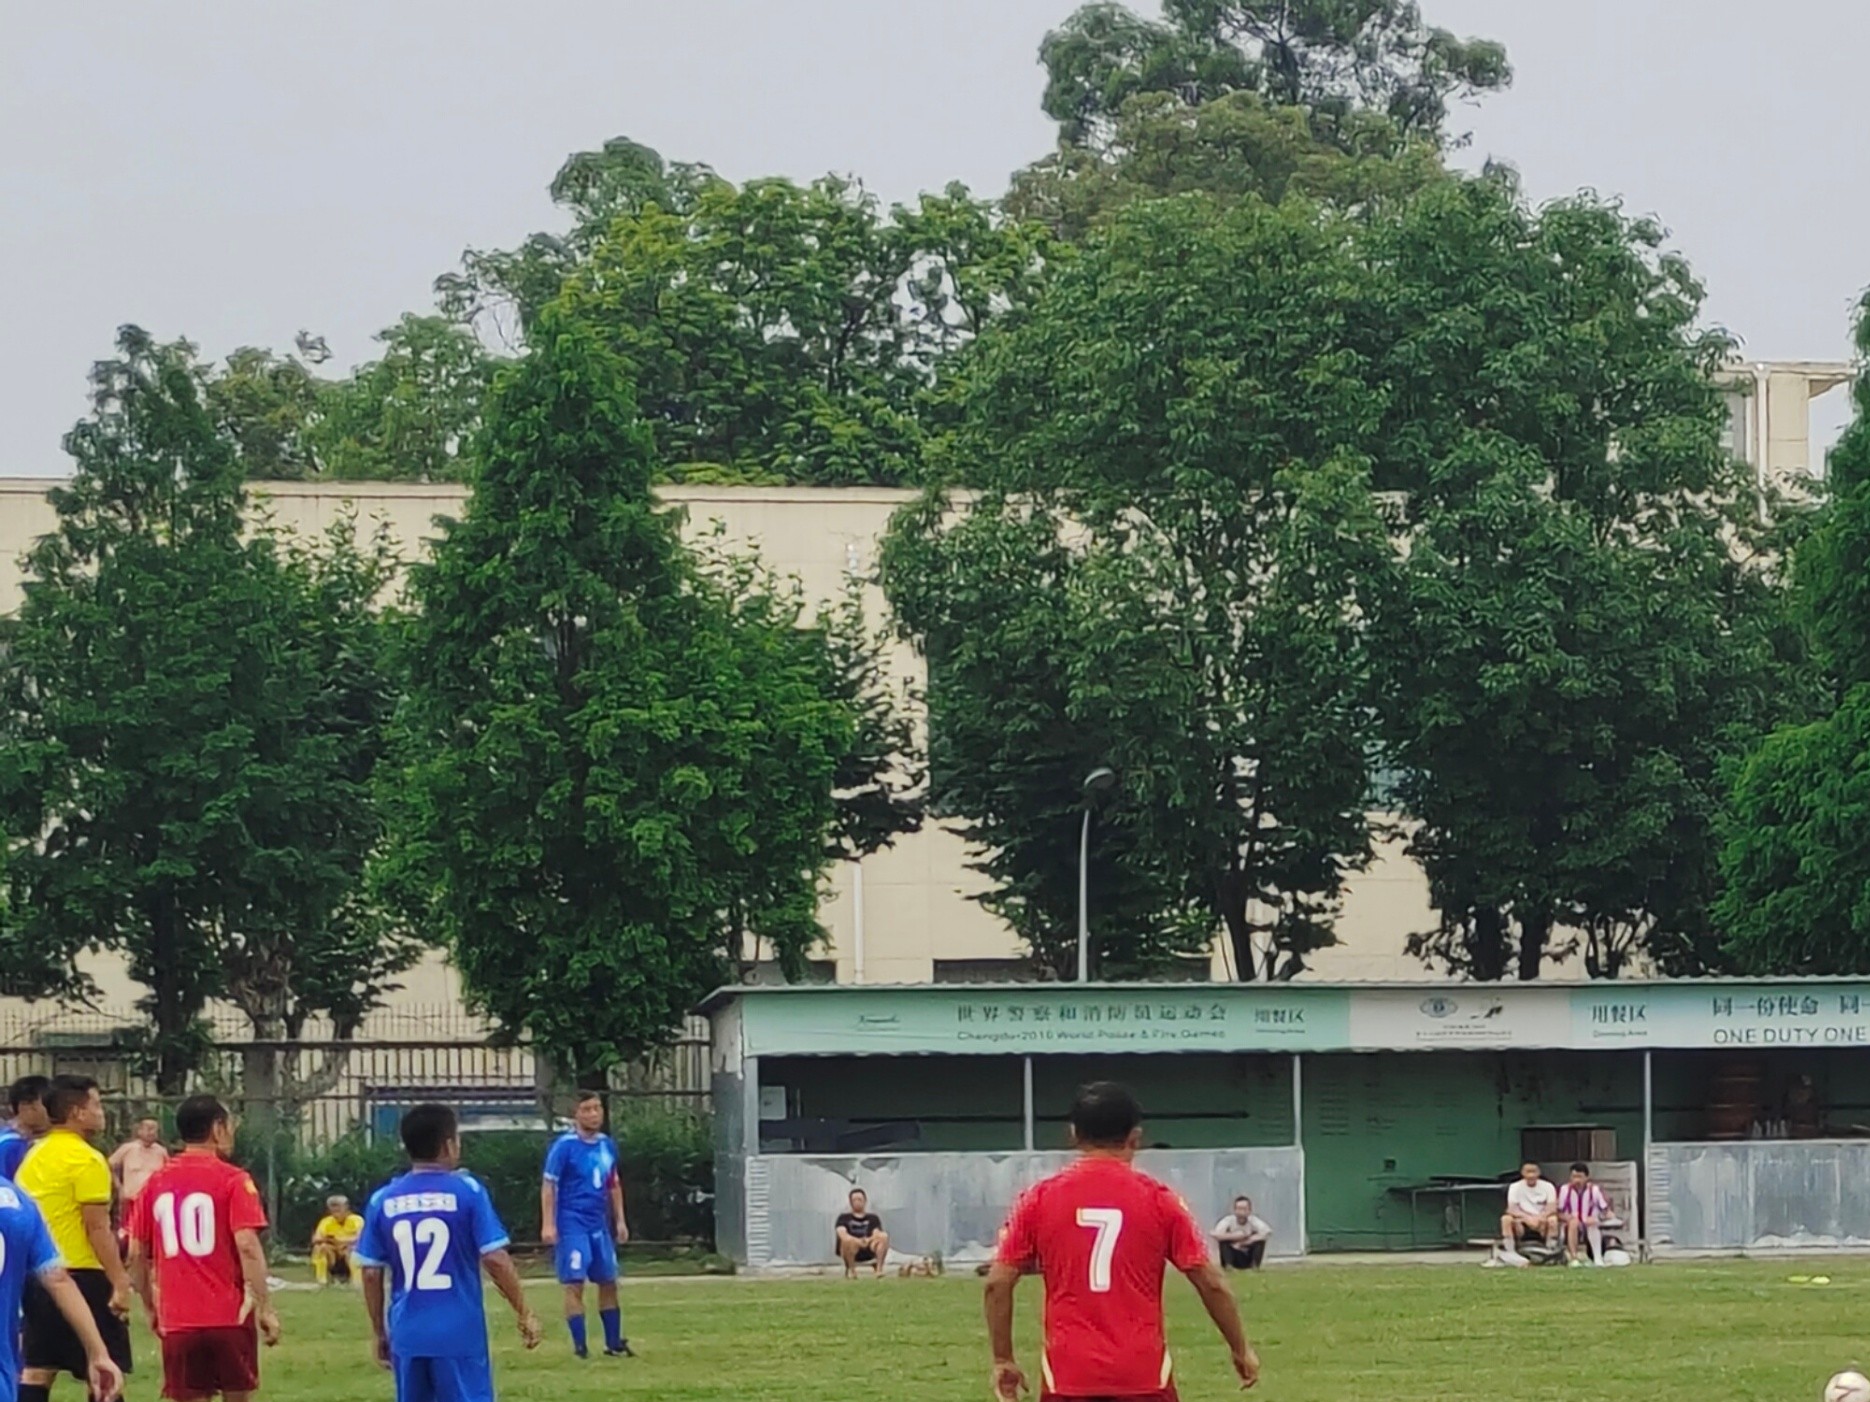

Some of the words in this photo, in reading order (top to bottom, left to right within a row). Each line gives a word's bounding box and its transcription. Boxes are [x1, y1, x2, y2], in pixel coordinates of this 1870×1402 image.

[1713, 995, 1819, 1017] 同一份使命
[1713, 1028, 1757, 1044] ONE
[1763, 1027, 1819, 1042] DUTY
[1824, 1027, 1868, 1042] ONE
[153, 1191, 216, 1259] 10
[393, 1217, 452, 1292] 12
[1075, 1207, 1123, 1292] 7
